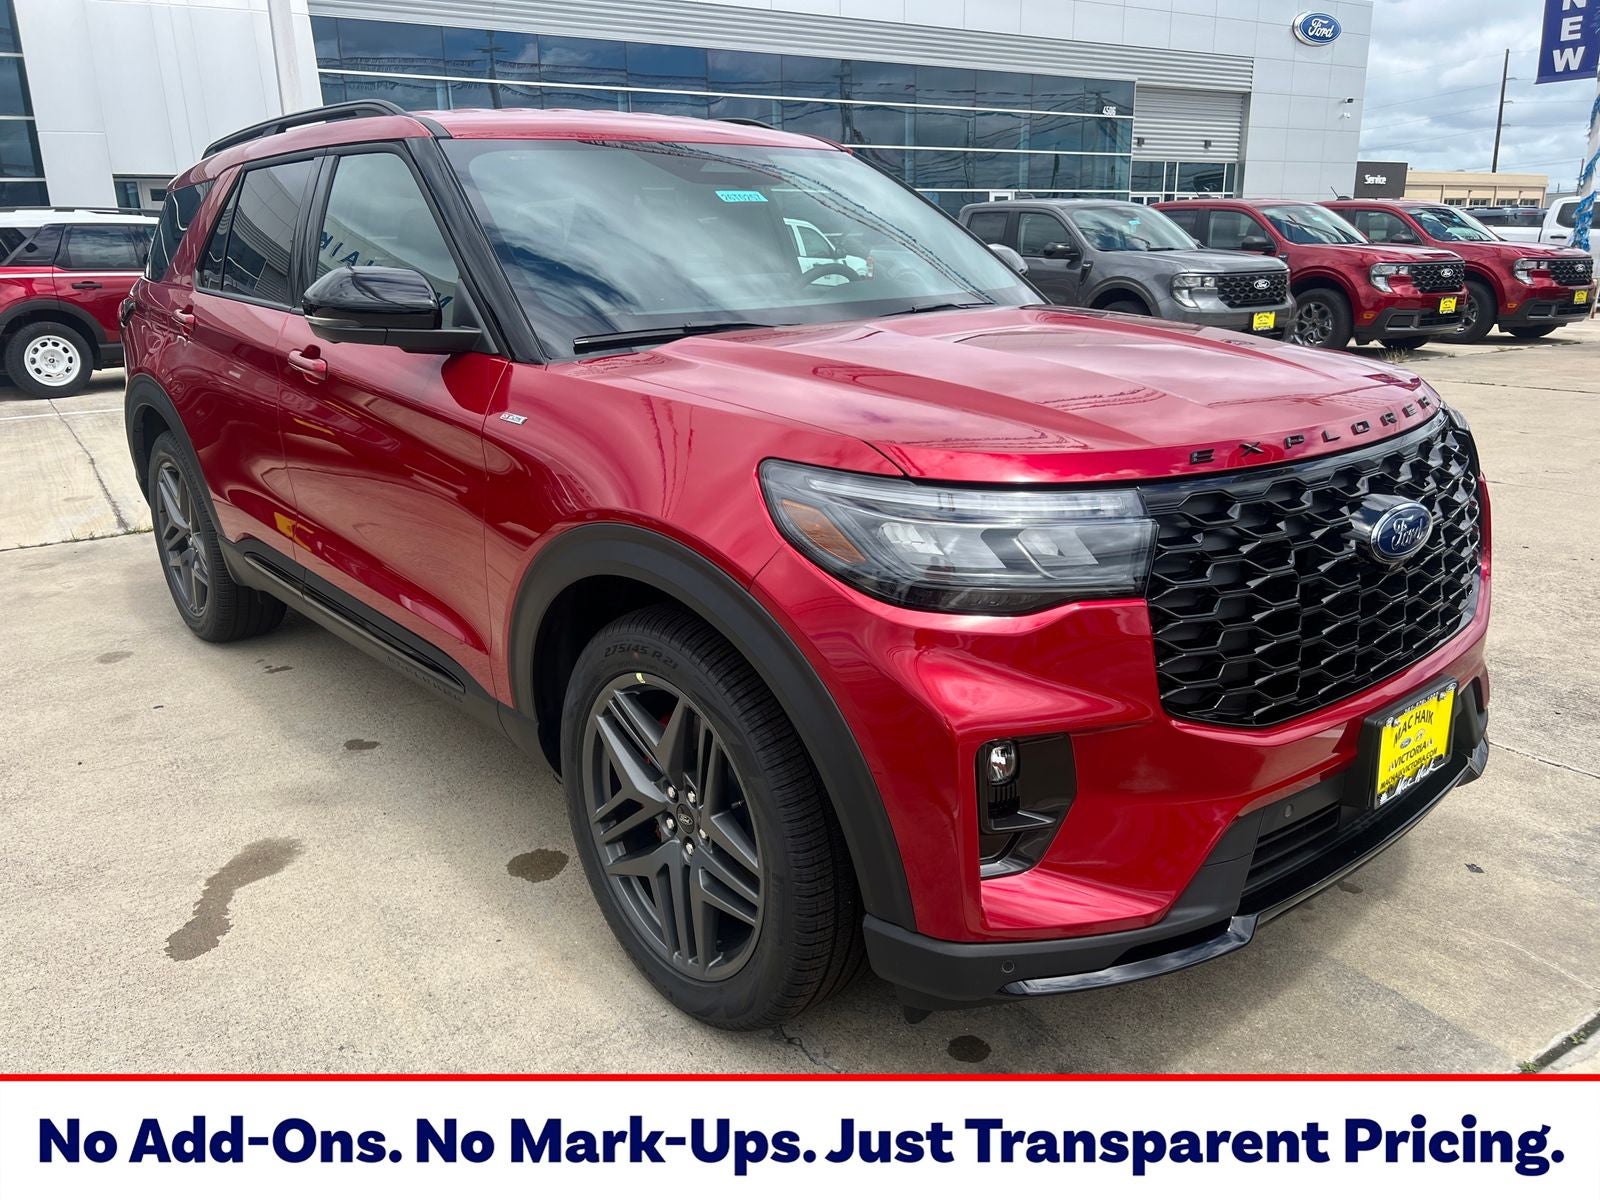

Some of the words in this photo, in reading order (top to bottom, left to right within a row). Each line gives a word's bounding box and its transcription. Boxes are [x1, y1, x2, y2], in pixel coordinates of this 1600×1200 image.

[1308, 18, 1334, 38] Ford
[1363, 174, 1387, 185] Service
[1190, 397, 1430, 465] EXPLORER
[1392, 515, 1424, 551] Ford
[604, 642, 649, 657] 275/45
[1393, 714, 1414, 747] MAC
[1414, 709, 1434, 725] HAIK
[1394, 740, 1427, 769] VICTORIA
